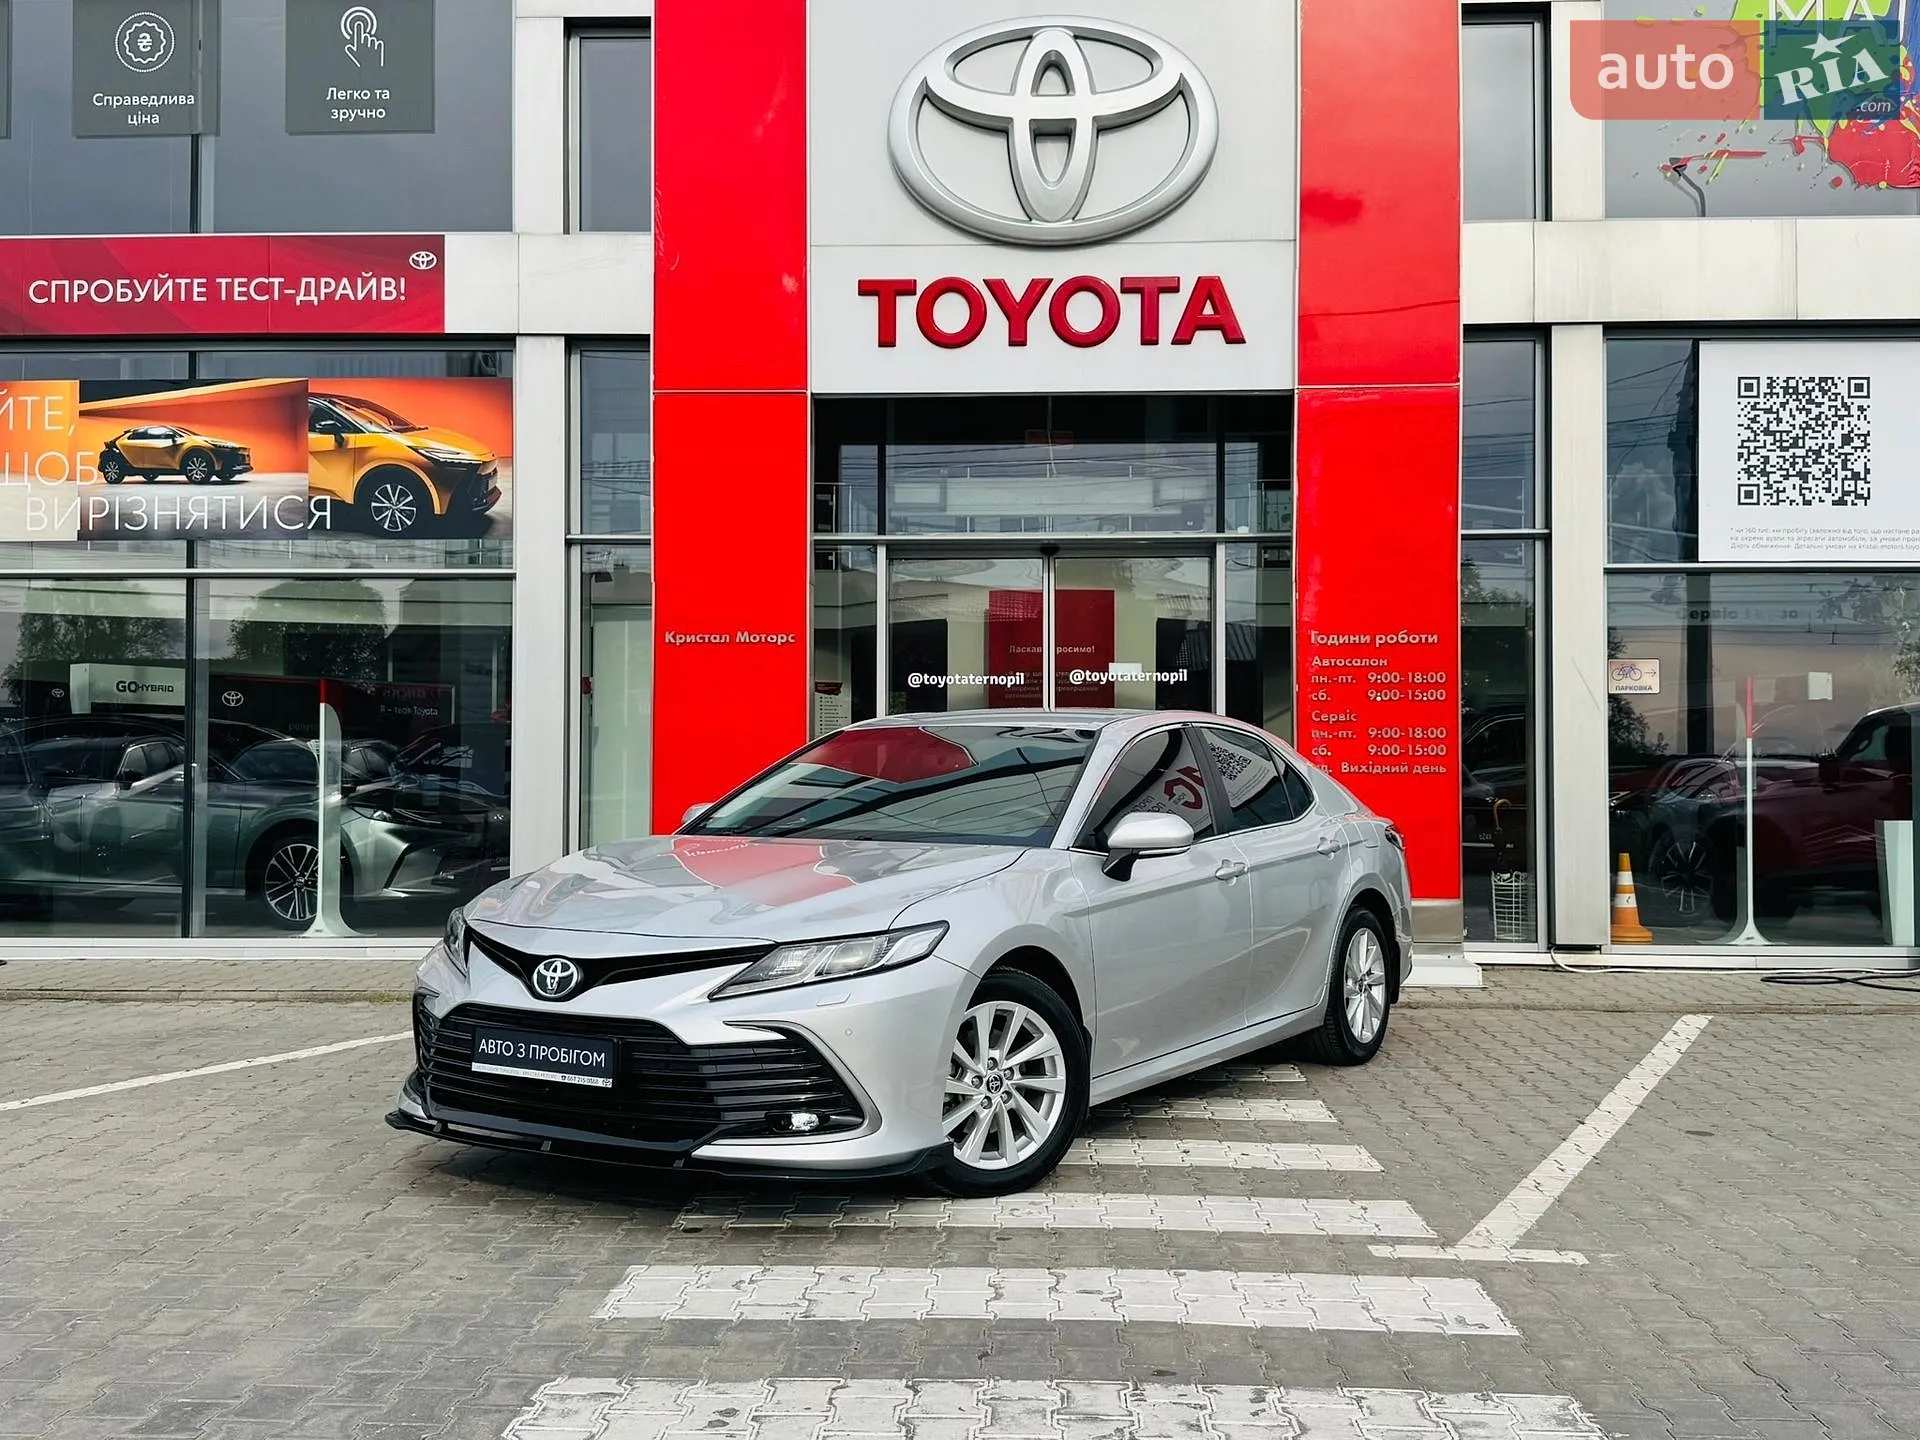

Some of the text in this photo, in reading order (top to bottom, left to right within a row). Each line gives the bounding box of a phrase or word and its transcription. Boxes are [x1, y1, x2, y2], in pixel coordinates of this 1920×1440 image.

[93, 93, 195, 108] Справедлива
[326, 87, 390, 102] Легко та
[128, 111, 160, 126] ціна
[330, 107, 387, 122] зручно
[29, 272, 407, 305] СПРОБУЙТЕ ТЕСТ-ДРАЙВ!
[858, 276, 1246, 348] TOYOTA
[26, 495, 331, 531] ВИРІЗНЯТИСЯ
[665, 630, 796, 645] Кристал Моторс
[1310, 629, 1438, 647] Години роботи
[1009, 644, 1042, 654] Ласкав
[1057, 644, 1095, 655] росимо!
[1311, 655, 1388, 667] Автосалон
[907, 671, 1025, 688] @toyotaternopil
[1069, 668, 1188, 685] @toyotaternopil
[1311, 671, 1446, 684] пн.-пт. 9:00-18:00
[1311, 688, 1446, 701] сб. 9:00-15:00
[413, 706, 438, 716] Toyota
[1311, 708, 1358, 724] Сервіс
[1311, 727, 1446, 739] пн.-пт. 9:00-18:00
[1311, 744, 1446, 756] сб. 9:00-15:00
[1341, 761, 1409, 775] Вихідний
[1412, 765, 1447, 775] день
[478, 1038, 606, 1068] АВТО З ПРОБІГОМ
